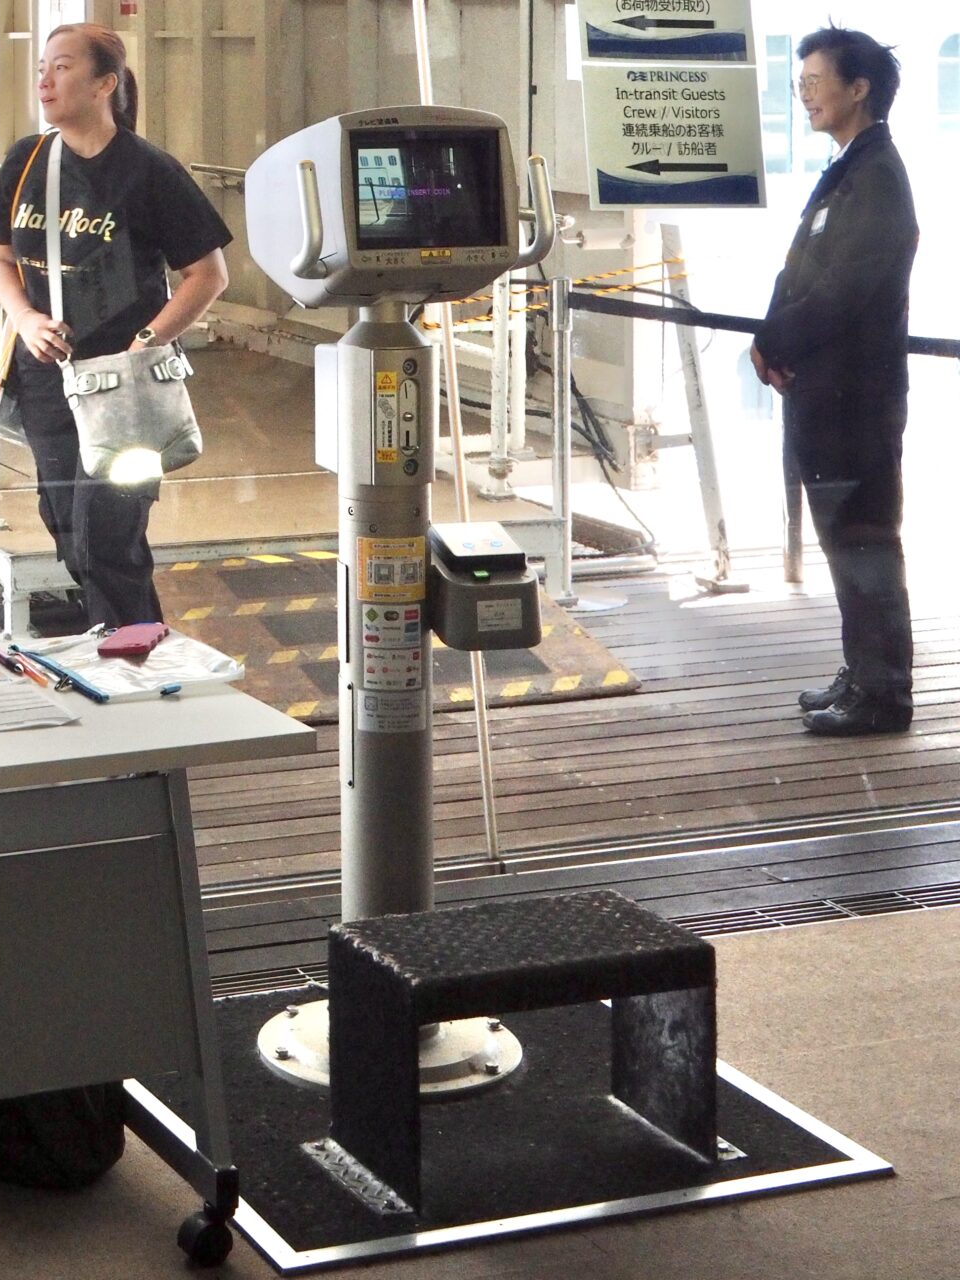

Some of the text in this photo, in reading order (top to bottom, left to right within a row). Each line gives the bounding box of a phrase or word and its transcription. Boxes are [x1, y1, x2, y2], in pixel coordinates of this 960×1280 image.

[650, 71, 708, 83] PRINCESS
[616, 87, 726, 101] In-transit Guests
[623, 106, 721, 120] Crew / Visitors
[631, 142, 662, 156] クルー
